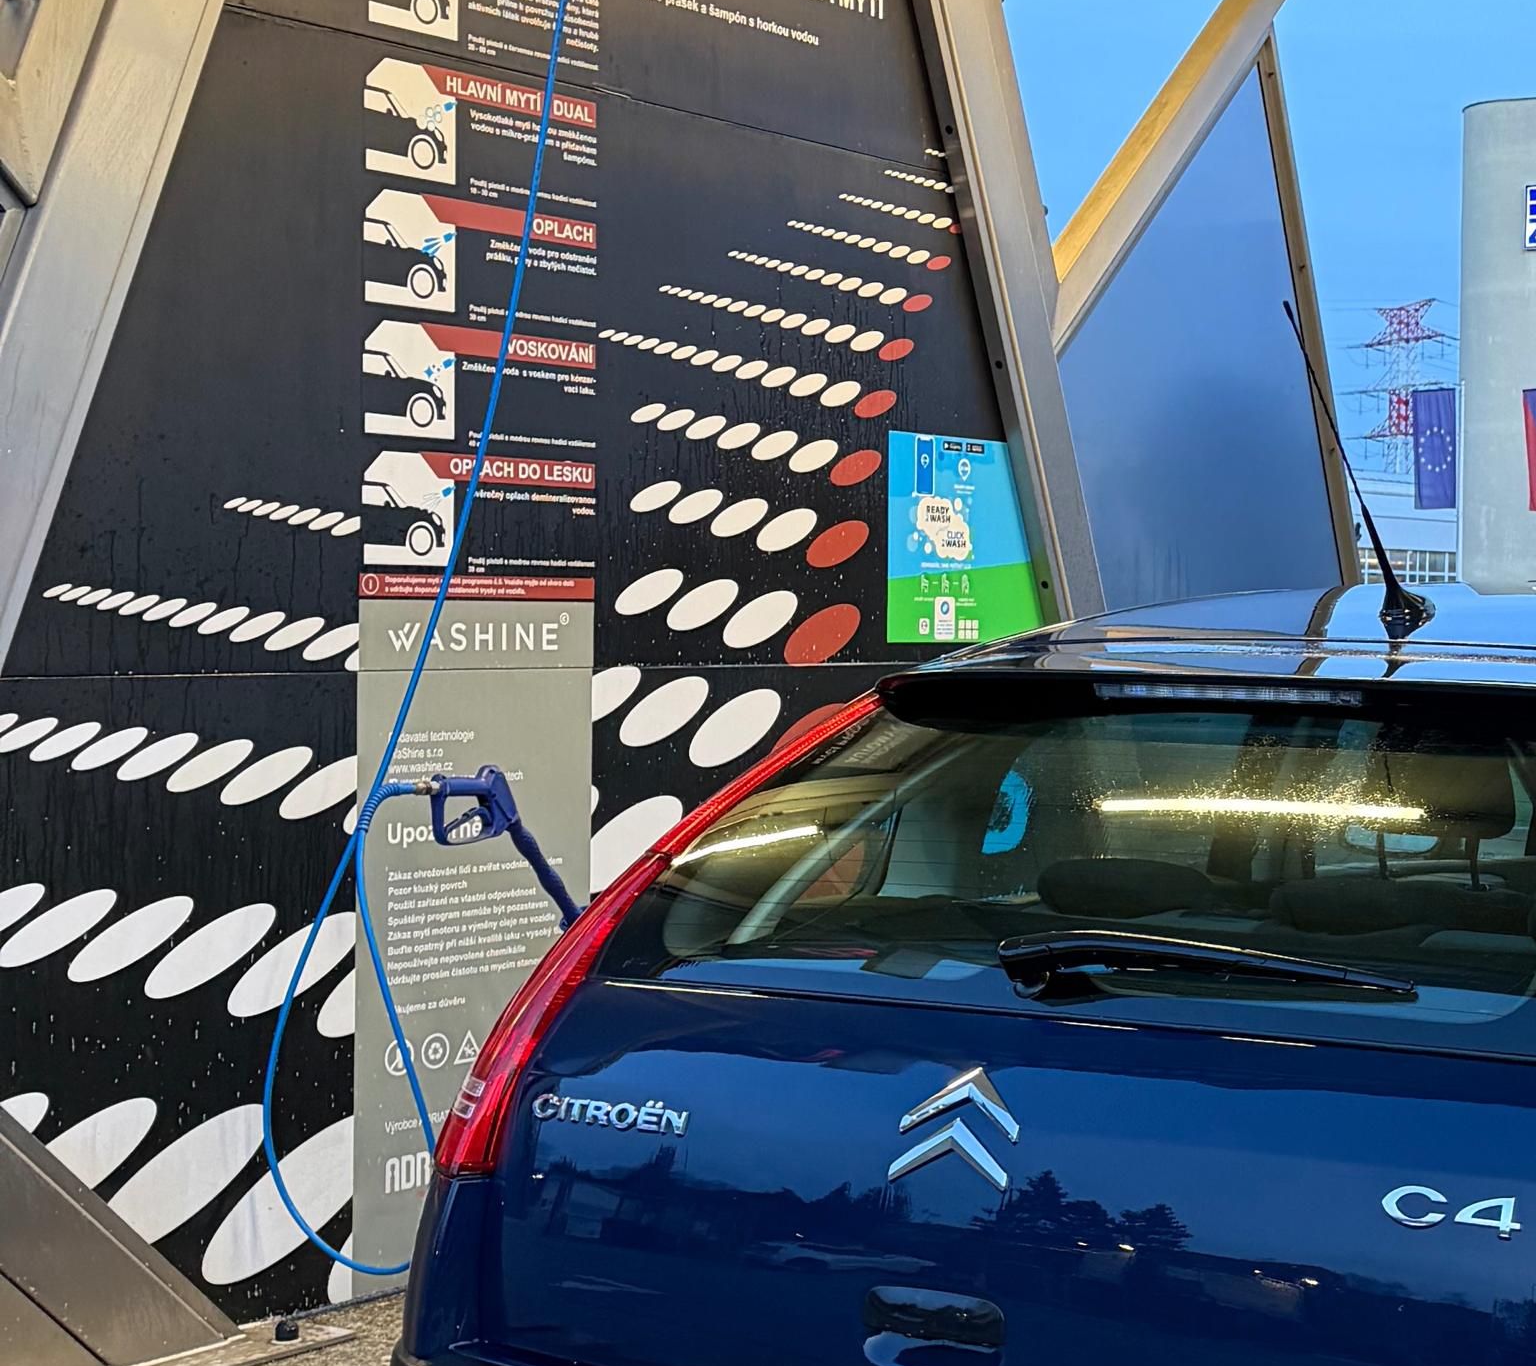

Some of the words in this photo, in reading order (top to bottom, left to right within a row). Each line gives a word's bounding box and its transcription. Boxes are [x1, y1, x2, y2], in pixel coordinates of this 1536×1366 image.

[756, 16, 789, 37] horkou
[791, 26, 819, 45] vodou
[446, 75, 501, 103] HLAVNÍ
[505, 88, 541, 111] MYTÍ
[553, 100, 593, 123] DUAL
[533, 218, 593, 243] OPLACH
[508, 339, 594, 363] VOSKOVÁNÍ
[450, 458, 514, 478] OPACH
[519, 462, 541, 480] DO
[544, 464, 592, 483] LESKU
[388, 886, 412, 896] Pozor
[440, 880, 467, 892] povrch
[449, 896, 459, 904] na
[427, 911, 460, 923] program
[431, 925, 460, 935] motoru
[533, 1093, 689, 1135] CITROËN
[385, 1151, 431, 1194] ADR
[1381, 1185, 1521, 1240] C4
